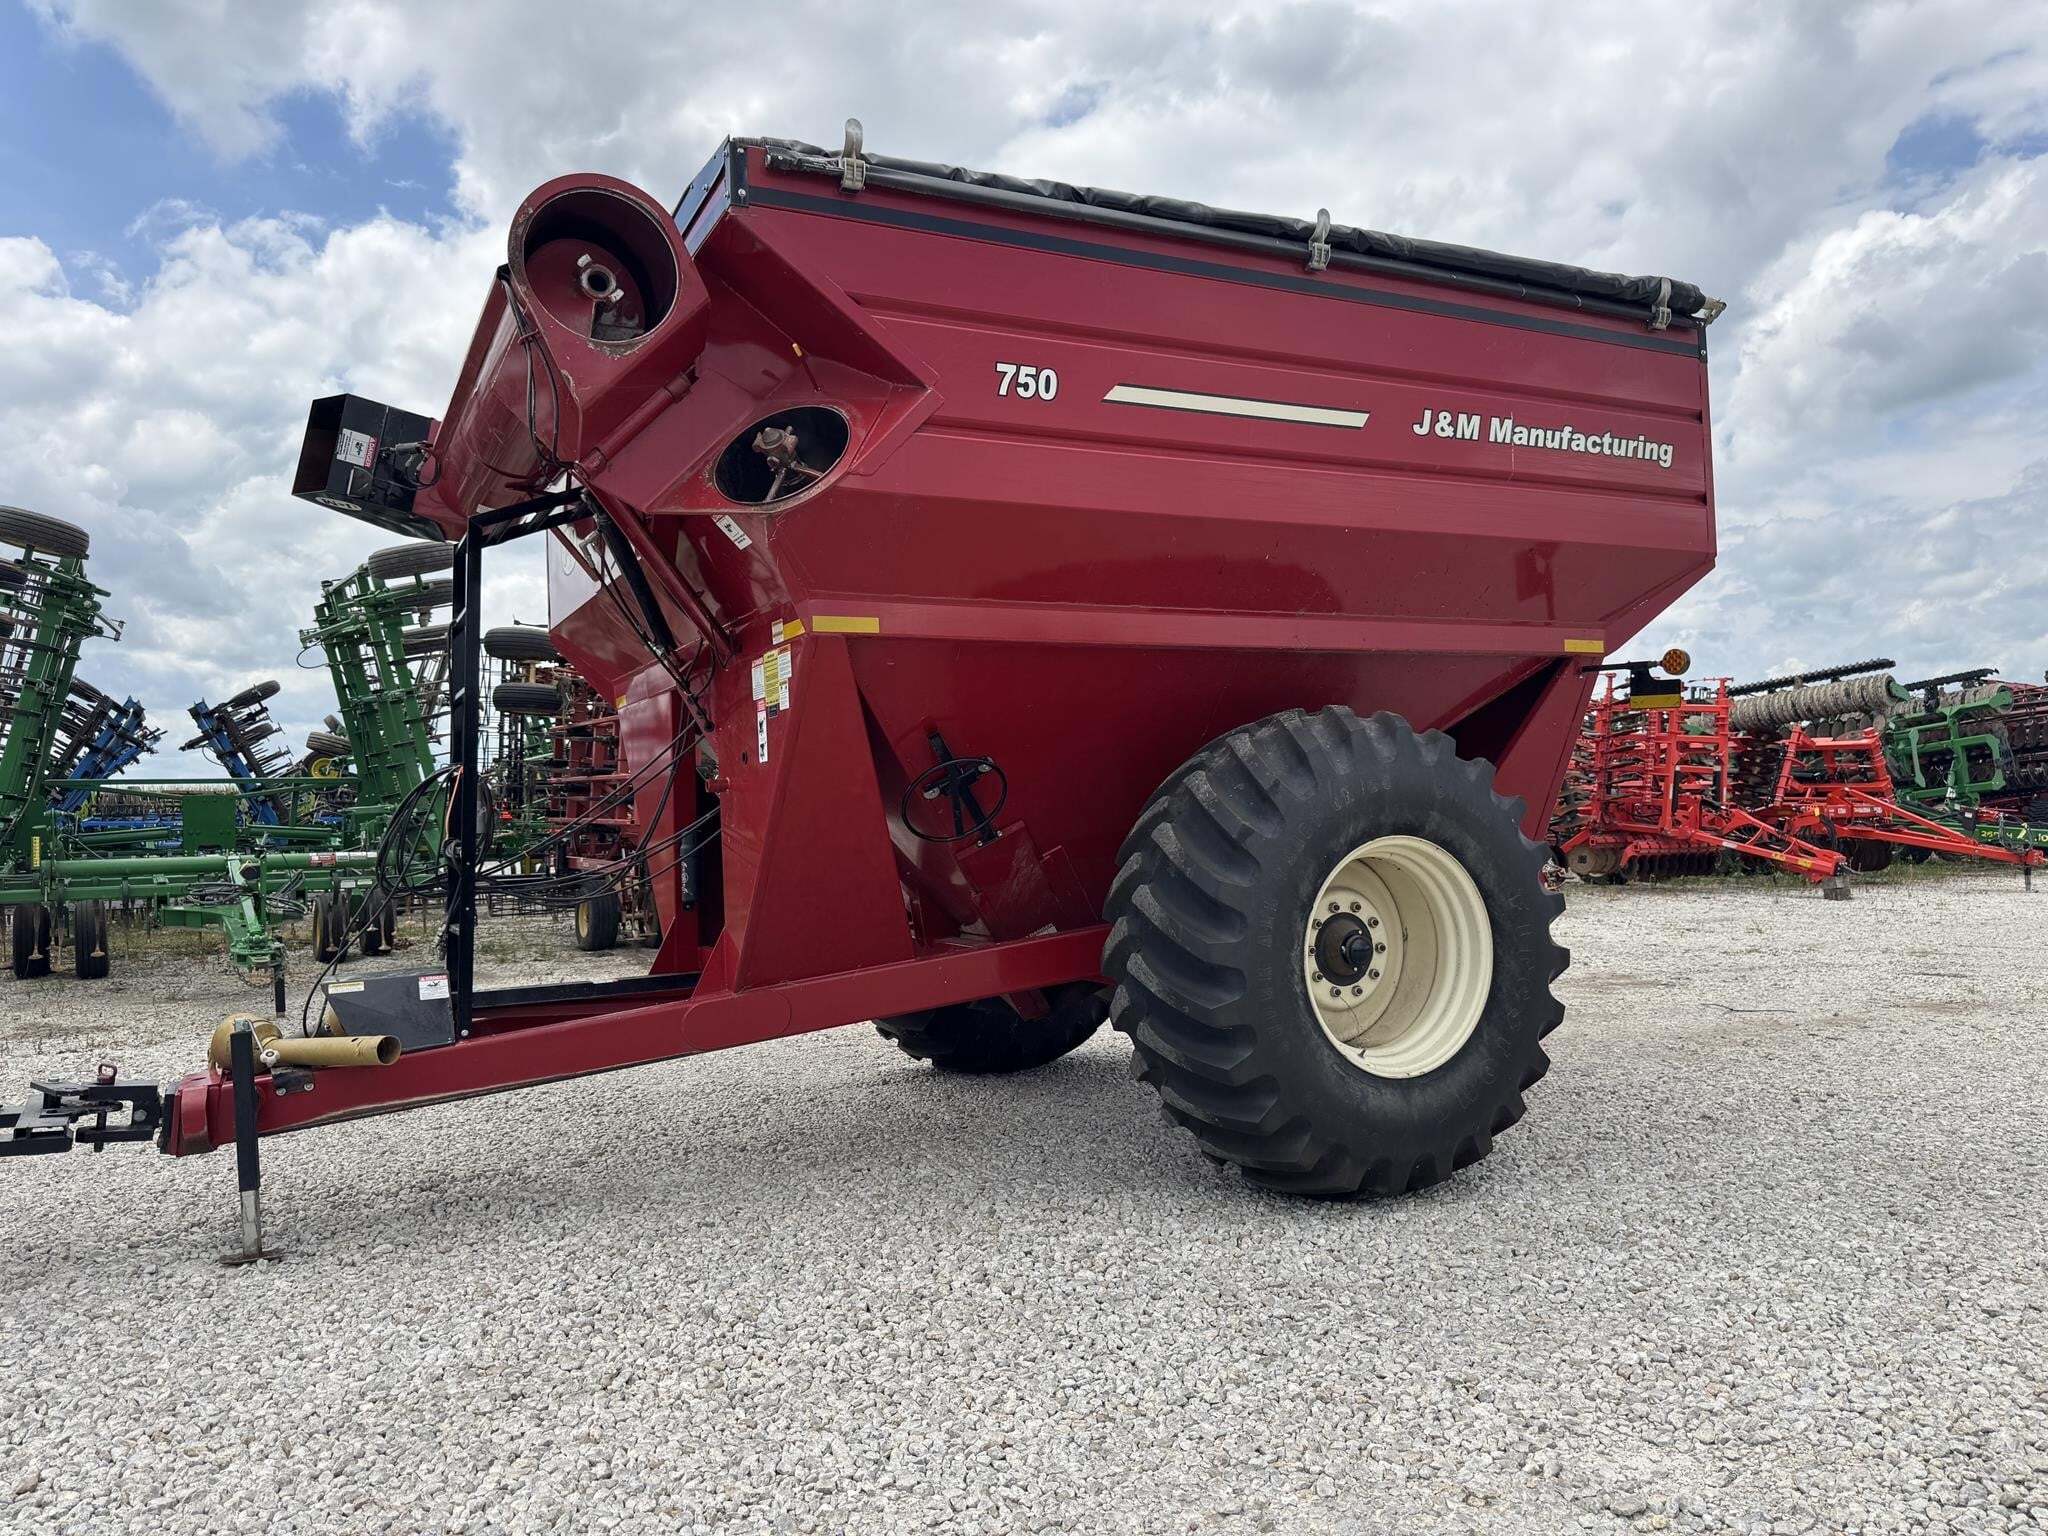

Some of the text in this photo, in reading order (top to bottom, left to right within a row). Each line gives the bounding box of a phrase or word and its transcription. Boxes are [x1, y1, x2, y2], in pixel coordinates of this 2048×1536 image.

[995, 361, 1059, 401] 750
[364, 442, 375, 467] DANGER
[1412, 408, 1674, 468] J&M Manufacturing
